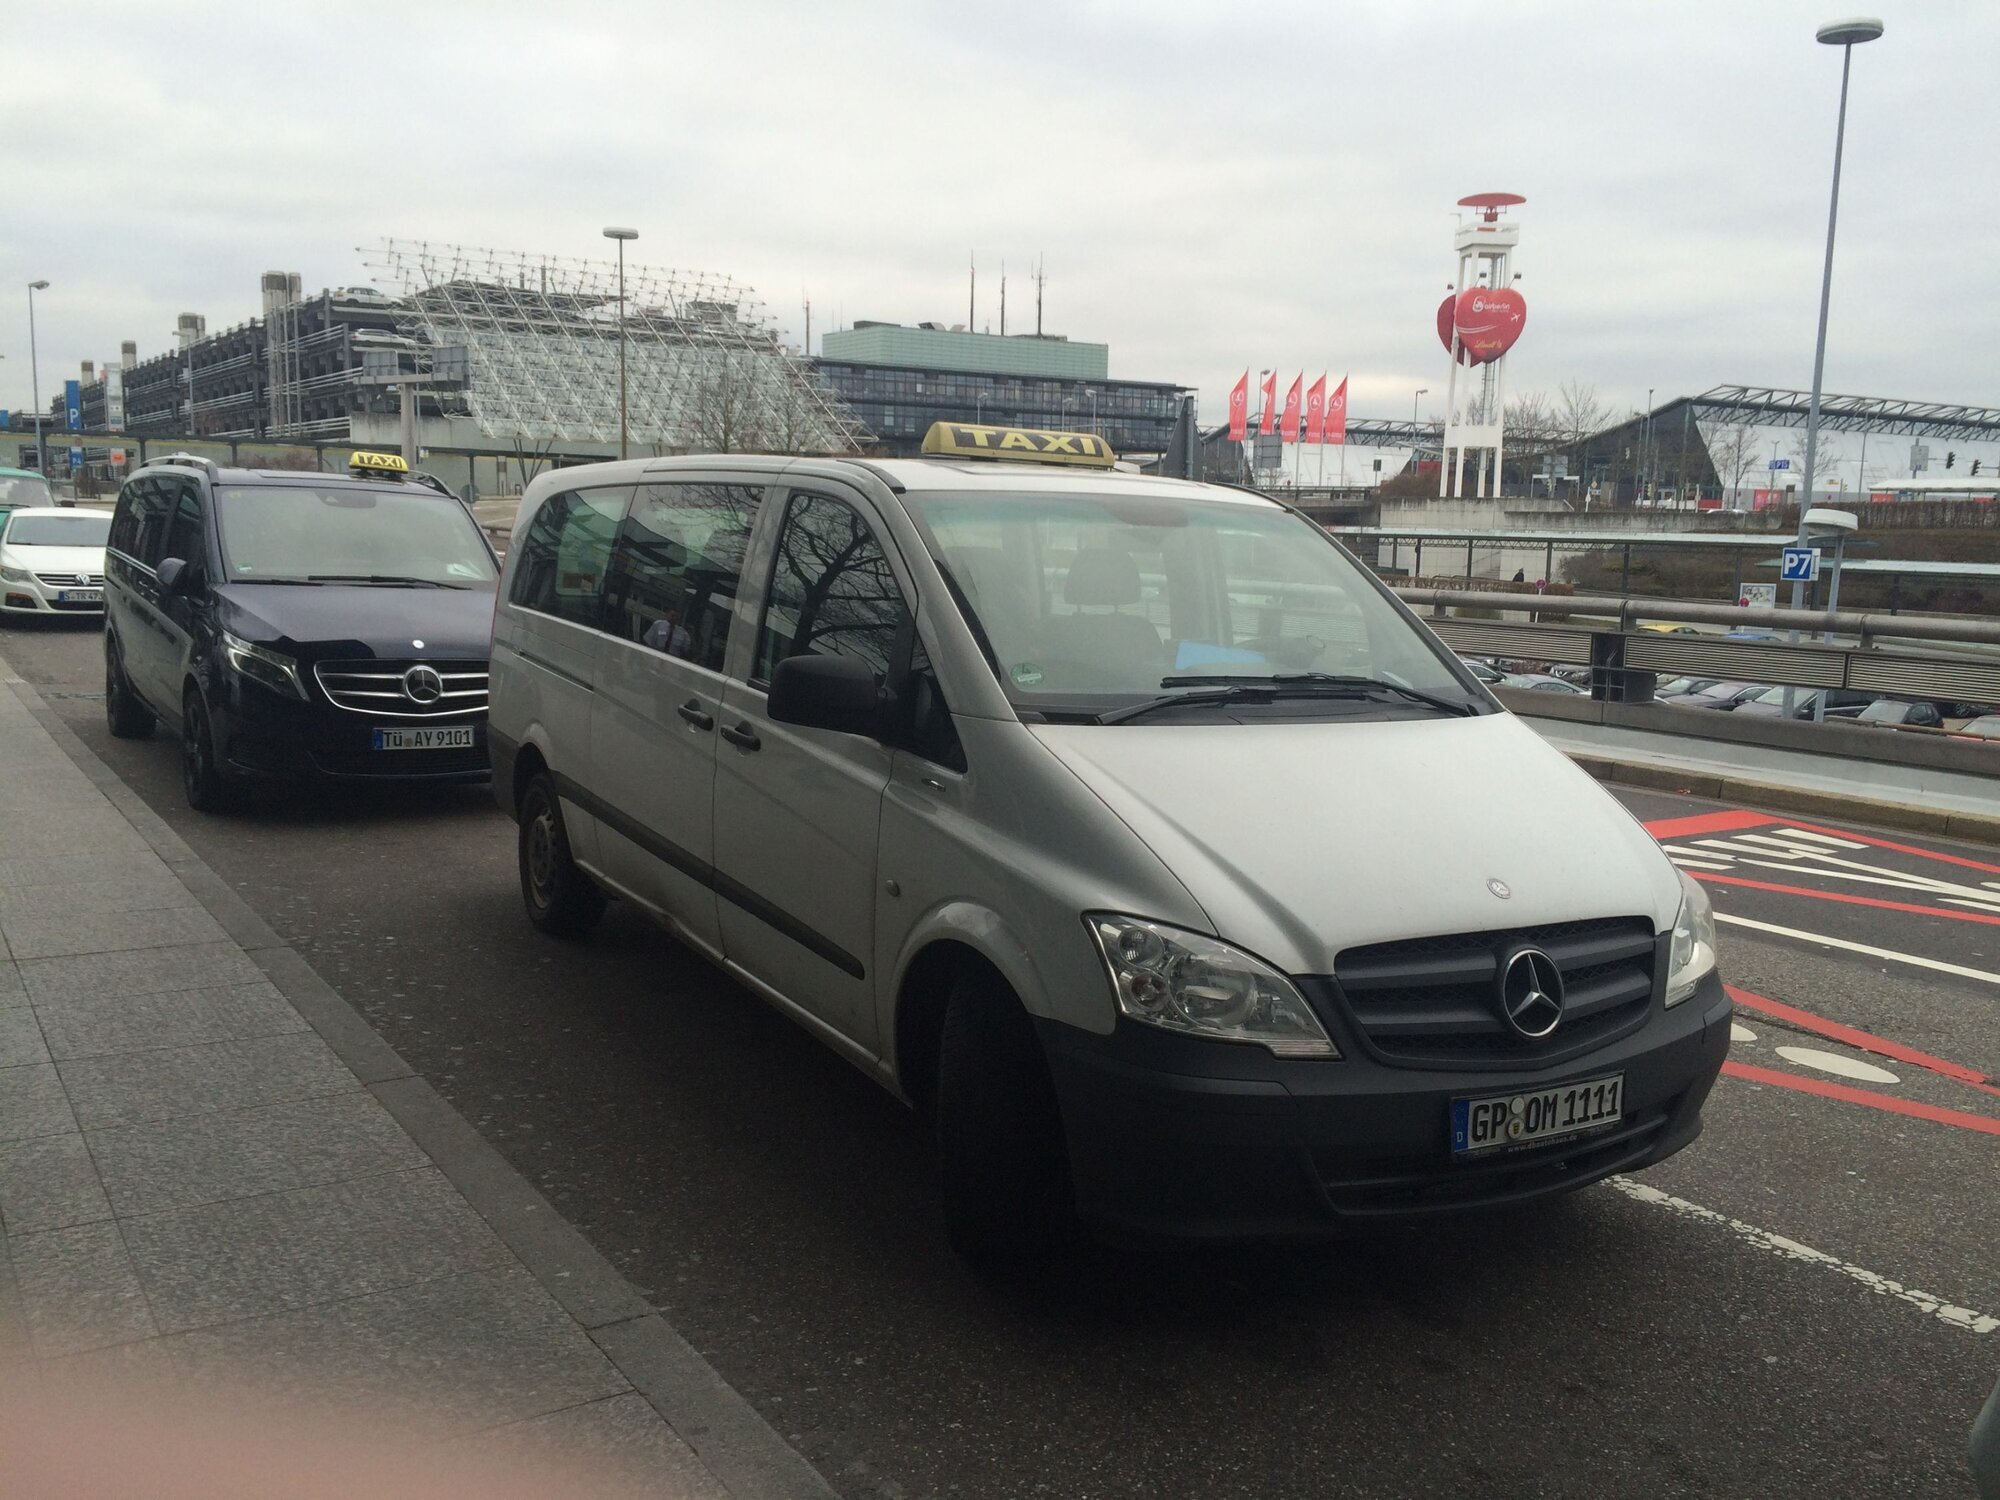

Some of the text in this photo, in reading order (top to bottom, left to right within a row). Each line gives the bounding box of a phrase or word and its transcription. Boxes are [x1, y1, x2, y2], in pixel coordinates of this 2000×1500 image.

[69, 408, 79, 423] P
[959, 428, 1098, 455] TAXI
[359, 452, 401, 468] TAXI
[1783, 553, 1812, 576] P7
[383, 730, 471, 747] TÜ AY 9101
[1471, 1102, 1508, 1142] GP
[1525, 1093, 1559, 1133] OM
[1562, 1081, 1619, 1126] 1111
